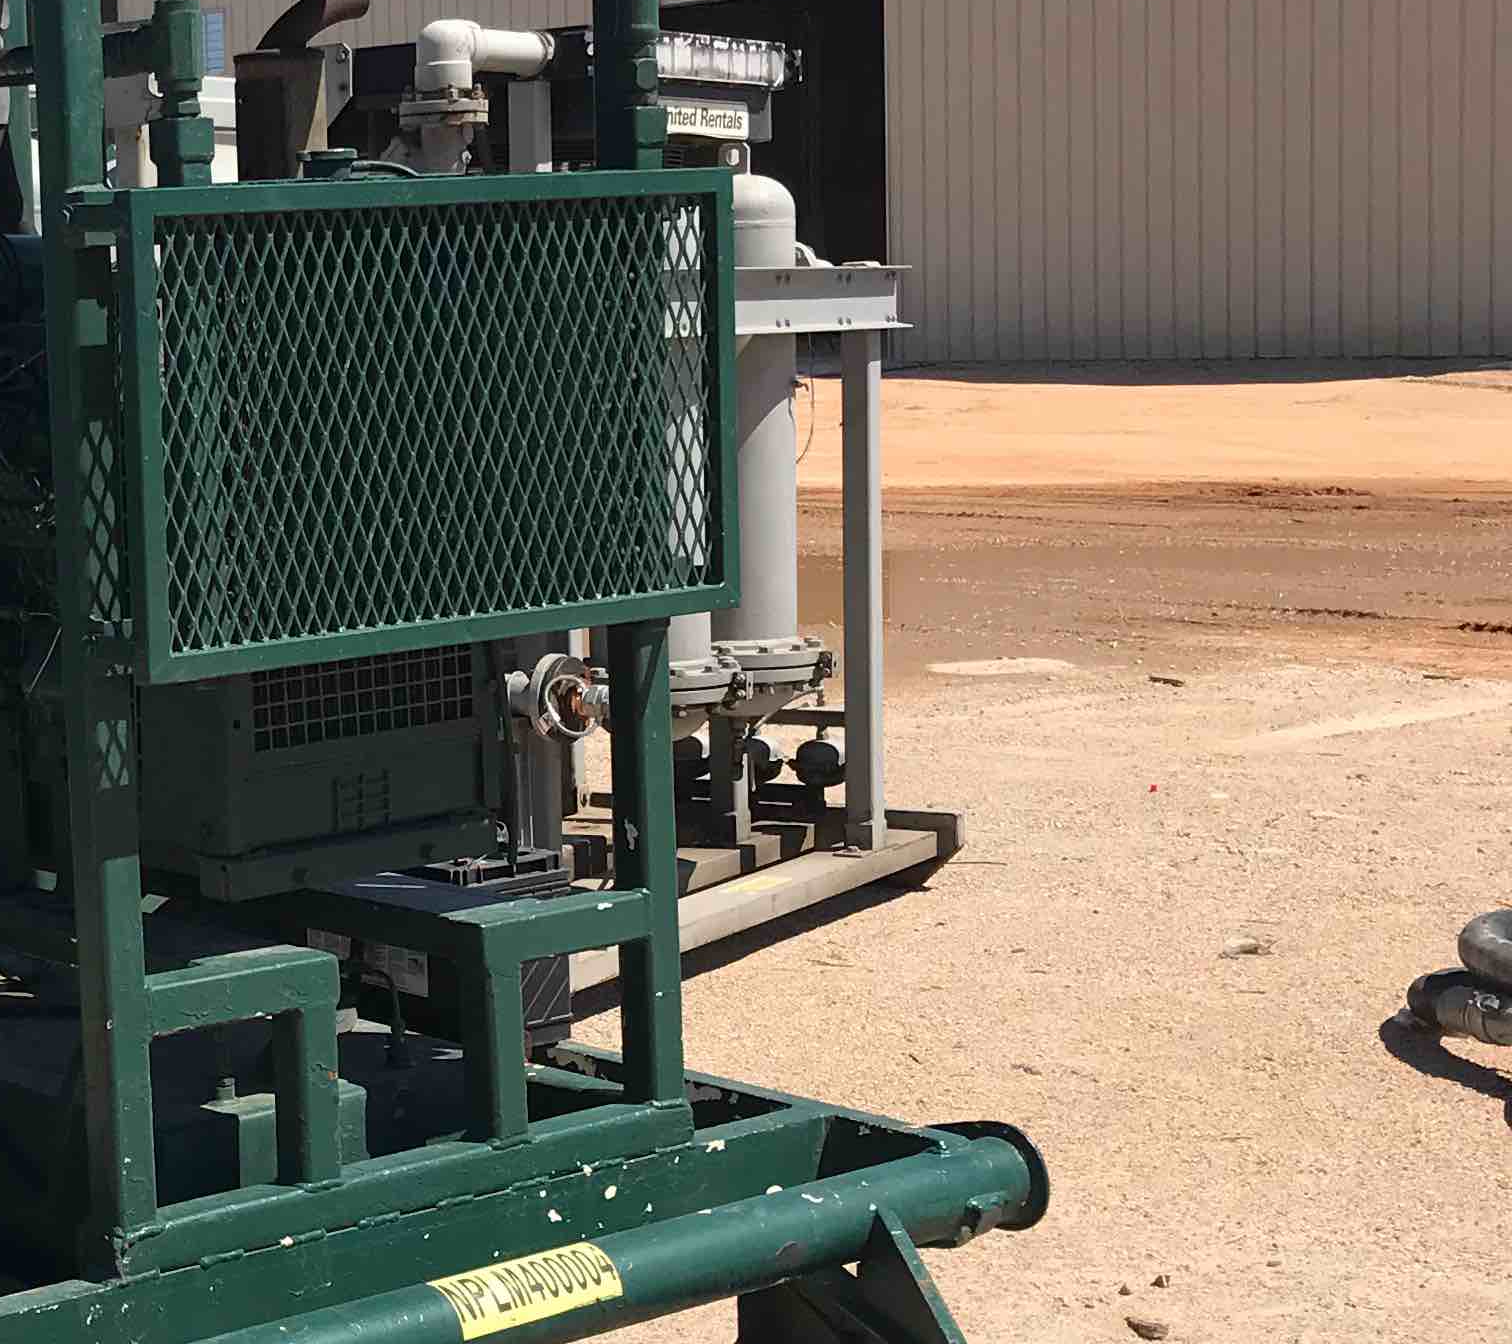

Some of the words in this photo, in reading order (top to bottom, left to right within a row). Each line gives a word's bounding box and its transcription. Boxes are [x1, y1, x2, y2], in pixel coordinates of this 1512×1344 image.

[667, 106, 697, 127] nited
[700, 107, 743, 130] Rentals
[438, 1246, 617, 1324] NPLM400004
